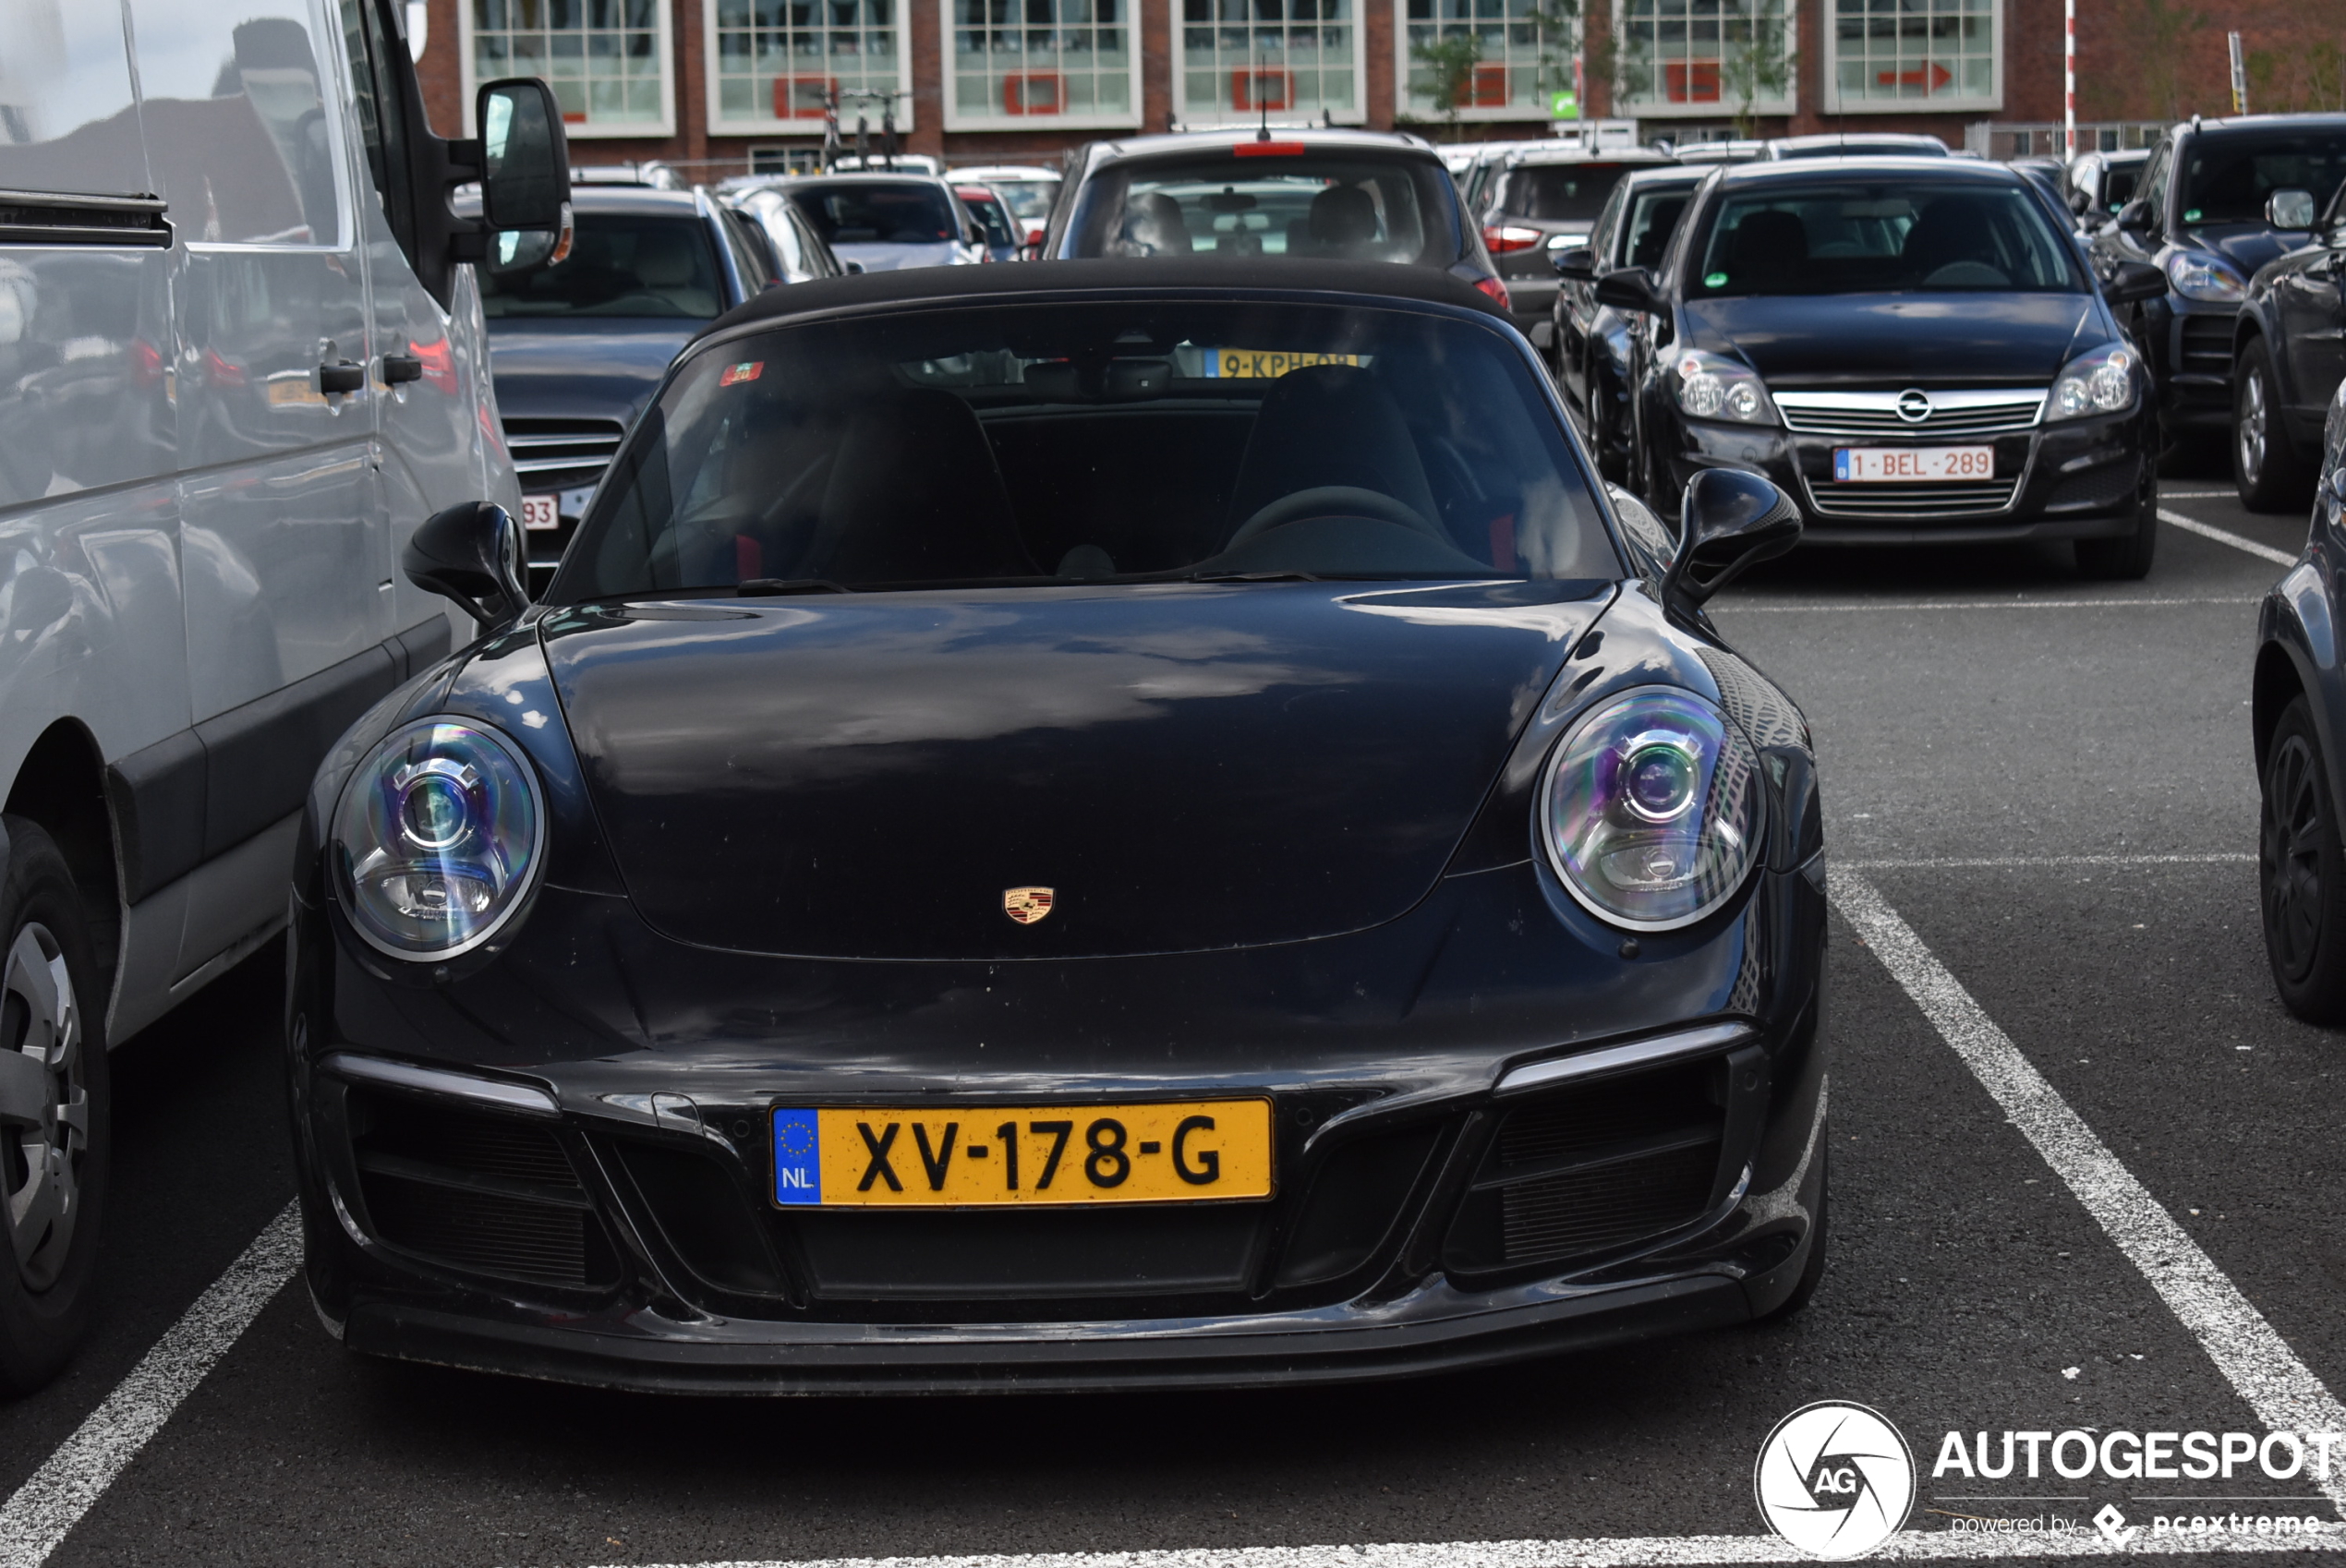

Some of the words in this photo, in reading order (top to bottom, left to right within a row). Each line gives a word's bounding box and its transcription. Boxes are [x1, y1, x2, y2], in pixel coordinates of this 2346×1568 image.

[1854, 452, 1989, 476] 1-BEL-289
[856, 1115, 1220, 1191] XV-178-G
[782, 1167, 815, 1188] NL
